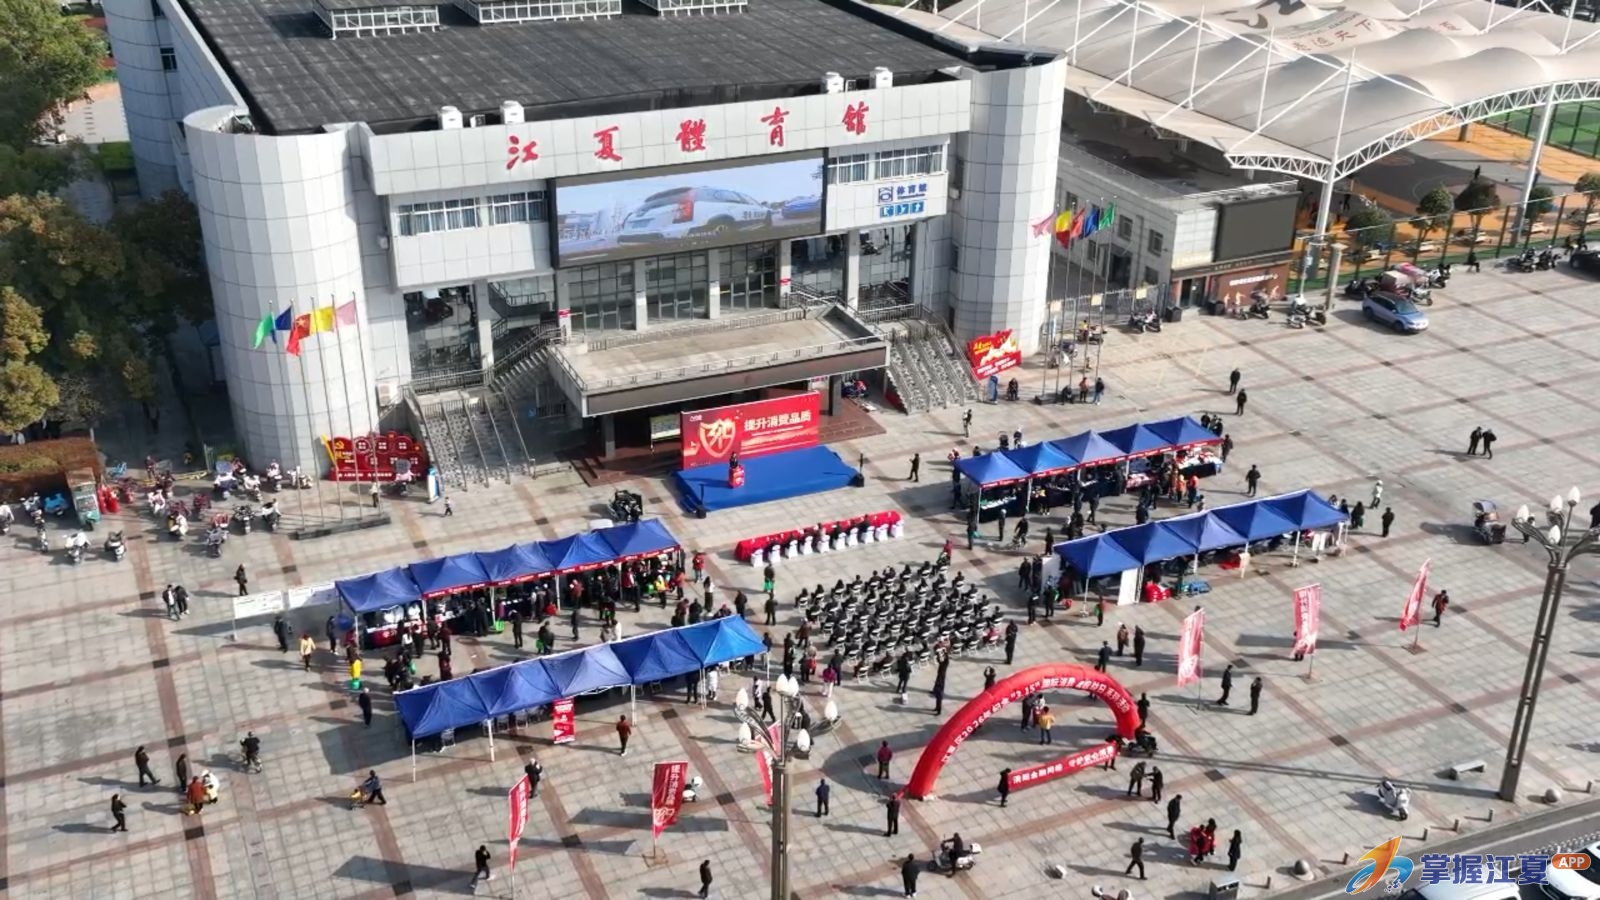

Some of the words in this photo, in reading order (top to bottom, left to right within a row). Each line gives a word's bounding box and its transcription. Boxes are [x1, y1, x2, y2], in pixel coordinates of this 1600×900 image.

[744, 410, 812, 432] 提升消费品质
